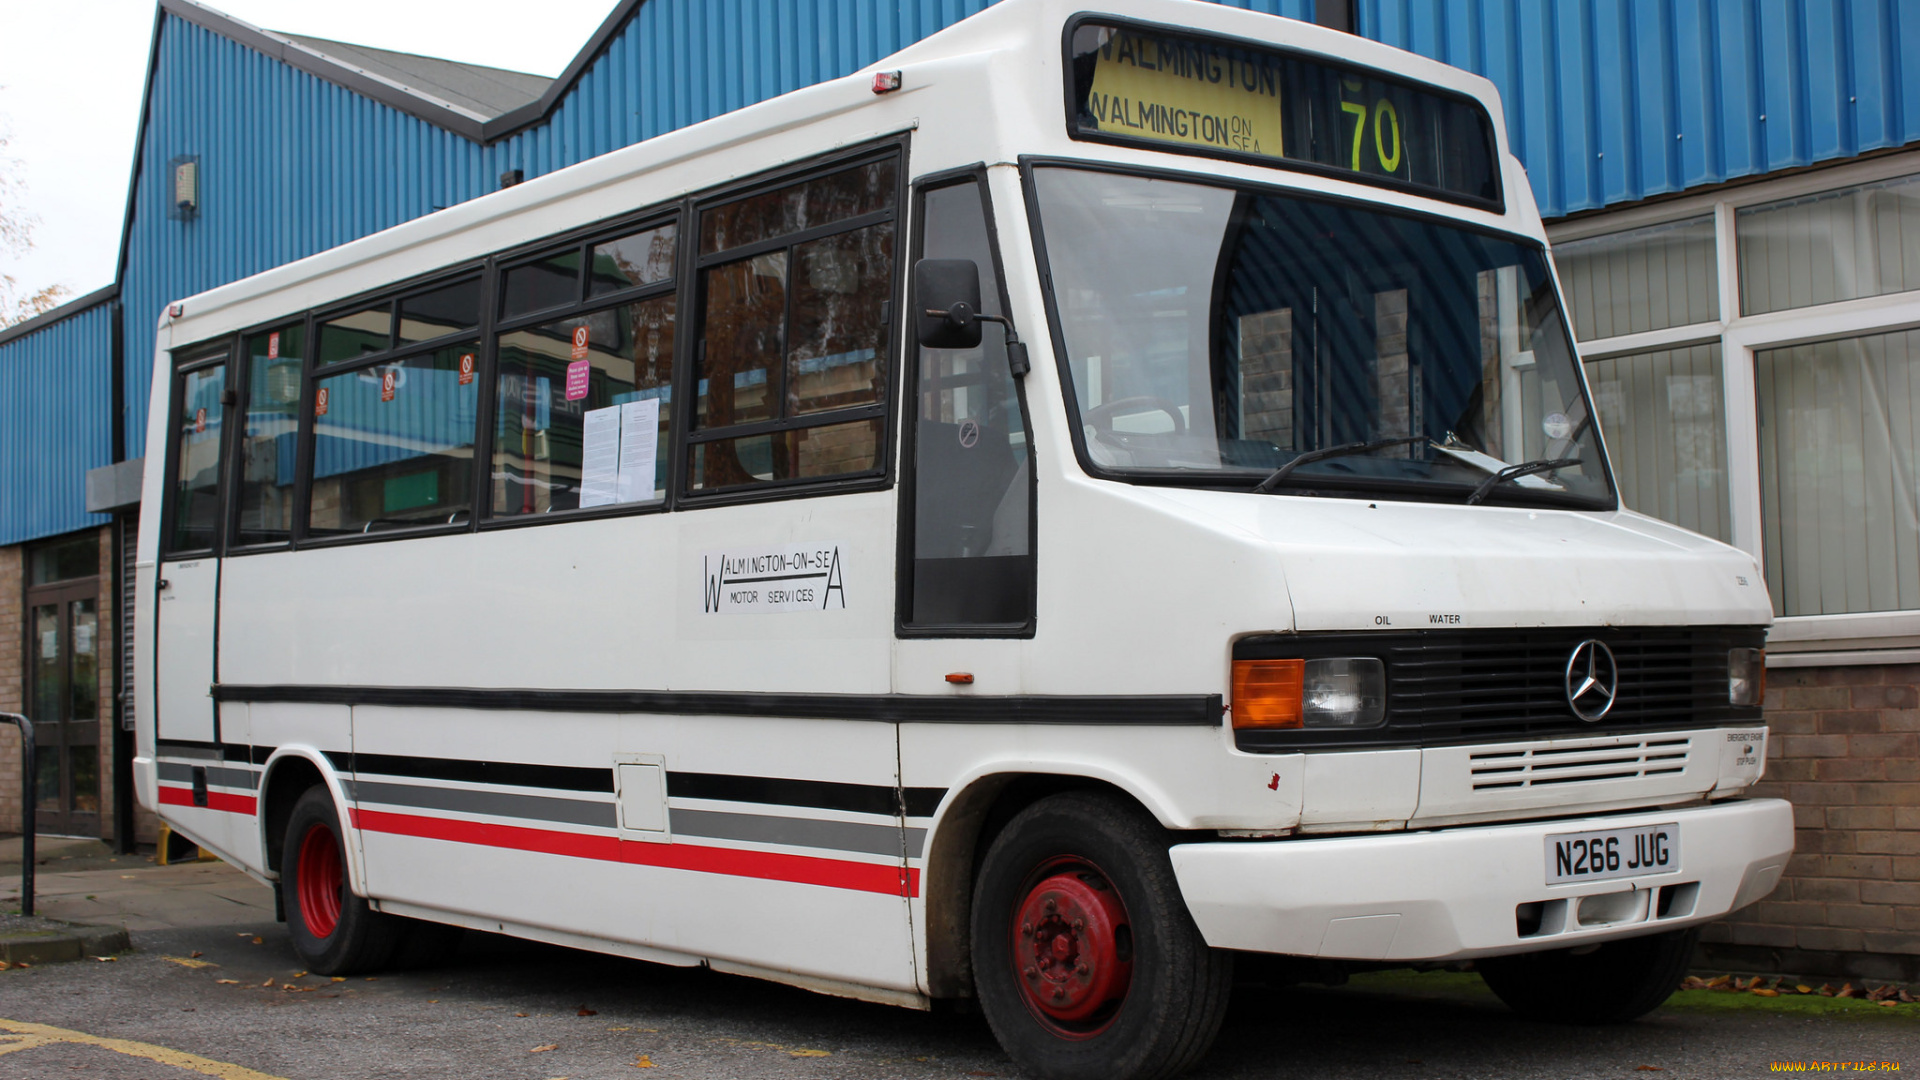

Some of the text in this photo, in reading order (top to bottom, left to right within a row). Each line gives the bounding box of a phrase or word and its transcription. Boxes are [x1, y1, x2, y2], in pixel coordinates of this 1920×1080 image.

[1231, 115, 1252, 137] ON
[1341, 98, 1400, 172] 70
[1232, 134, 1261, 153] SEA
[704, 545, 846, 613] WALMINGTON-ON-SEA
[730, 588, 814, 604] MOTOR SERVICES
[1374, 614, 1461, 625] OIL WATER
[1727, 733, 1750, 742] EMERGENCY
[1555, 832, 1669, 877] N266 JUG
